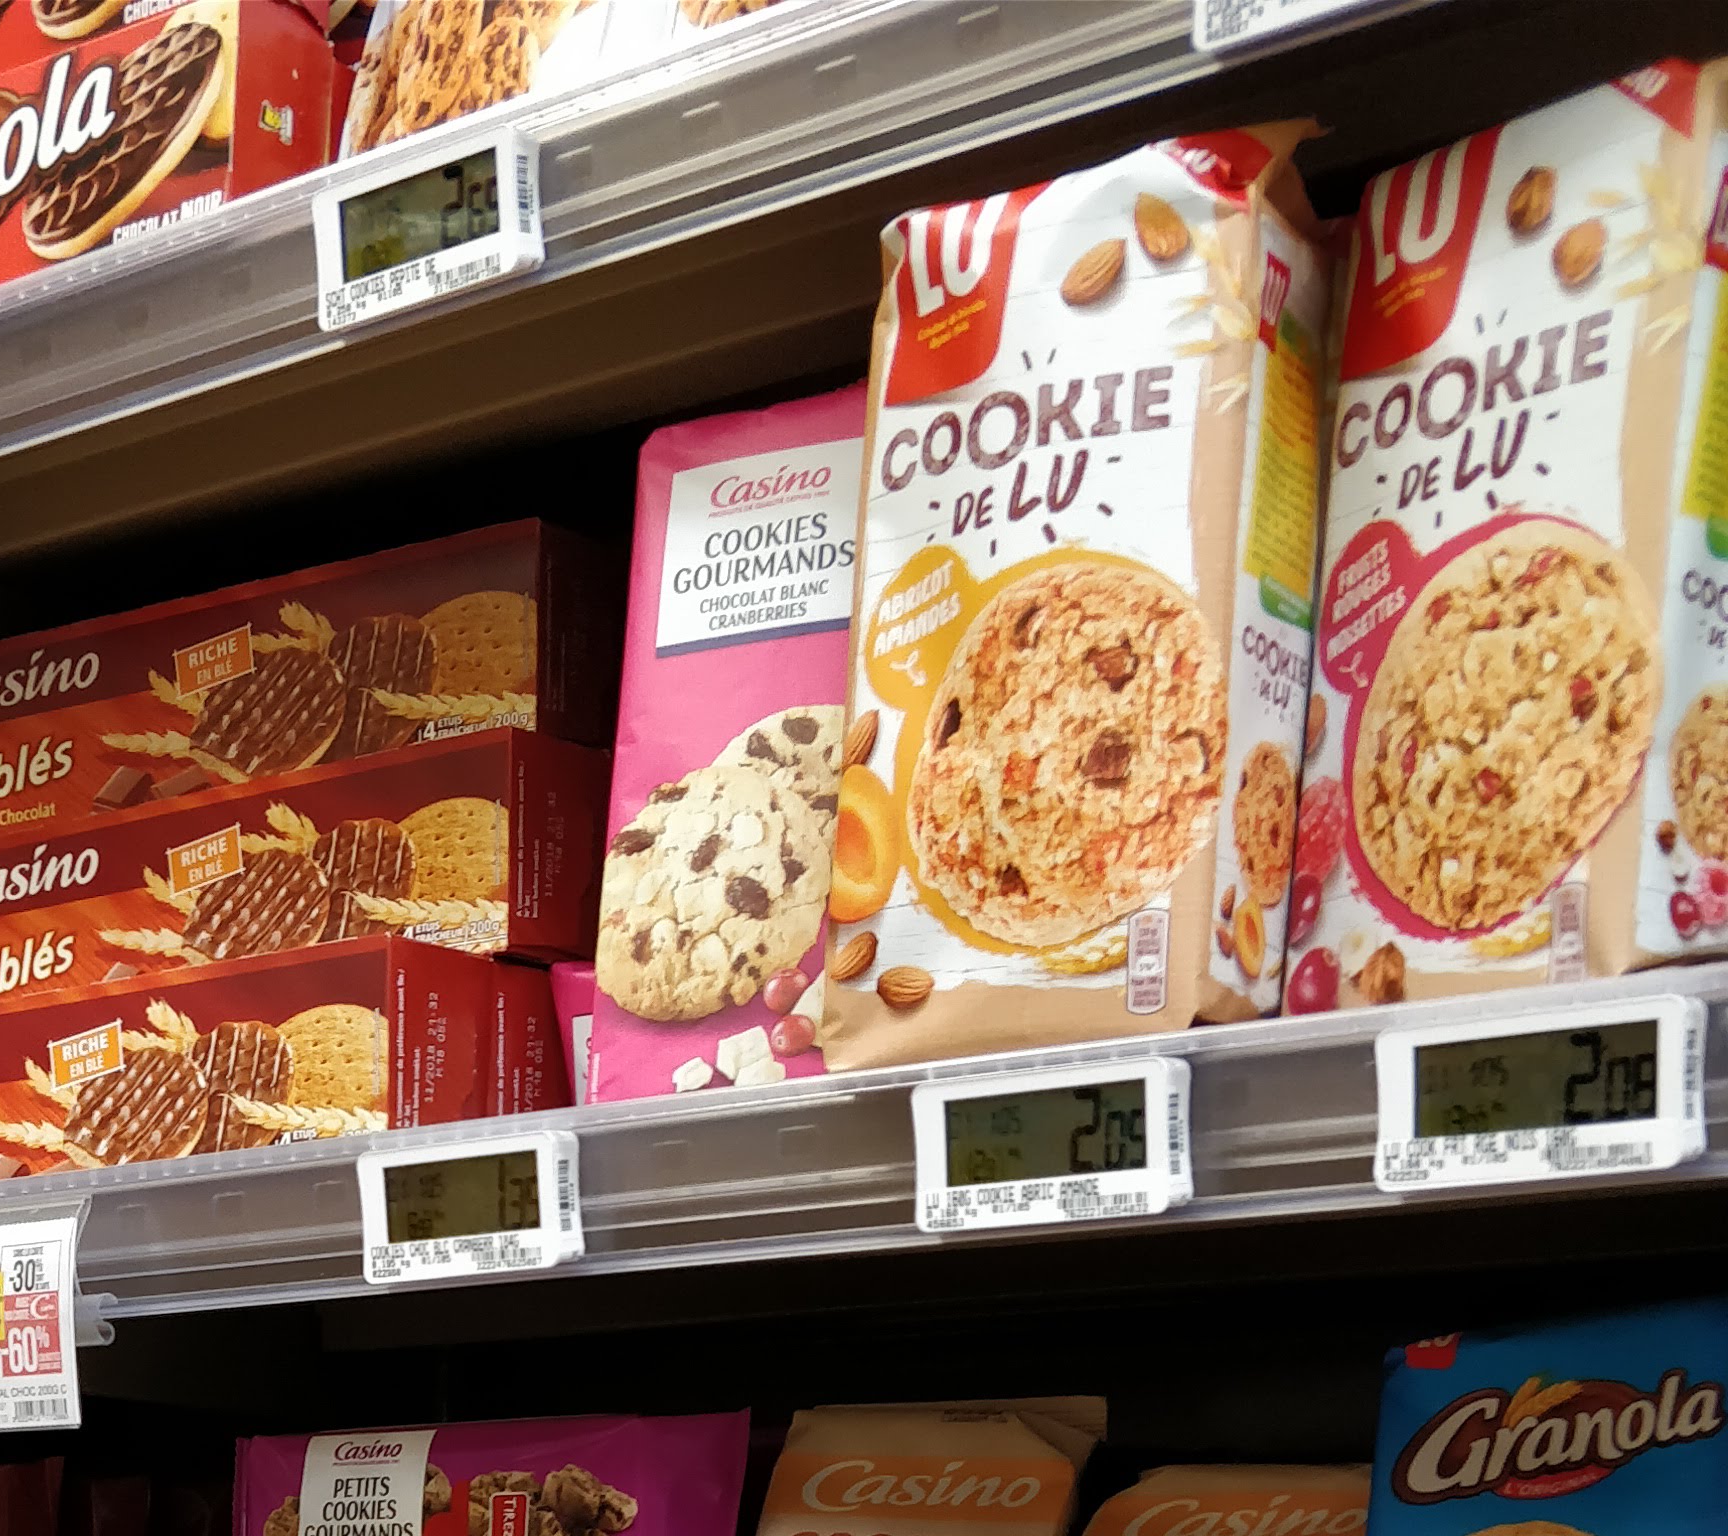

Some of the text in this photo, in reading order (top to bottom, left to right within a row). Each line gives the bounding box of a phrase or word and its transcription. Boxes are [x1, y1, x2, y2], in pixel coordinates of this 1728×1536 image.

[1336, 310, 1613, 469] COOKIE
[880, 365, 1174, 492] COOKIE
[1398, 408, 1531, 510] DE LU
[704, 513, 829, 559] COOKIES
[673, 540, 856, 595] GOURMANDS
[699, 580, 830, 614] CHOCOLAT BLANC
[708, 602, 808, 631] CRANBERRIES
[187, 638, 238, 668] RICHE
[196, 657, 235, 681] EN BLÉ
[977, 1186, 1015, 1205] COOKIE
[333, 1438, 403, 1462] Casino
[333, 1476, 391, 1499] PETITS
[1504, 1471, 1601, 1497] L'ORIGINAL
[322, 1498, 398, 1522] COOKIES
